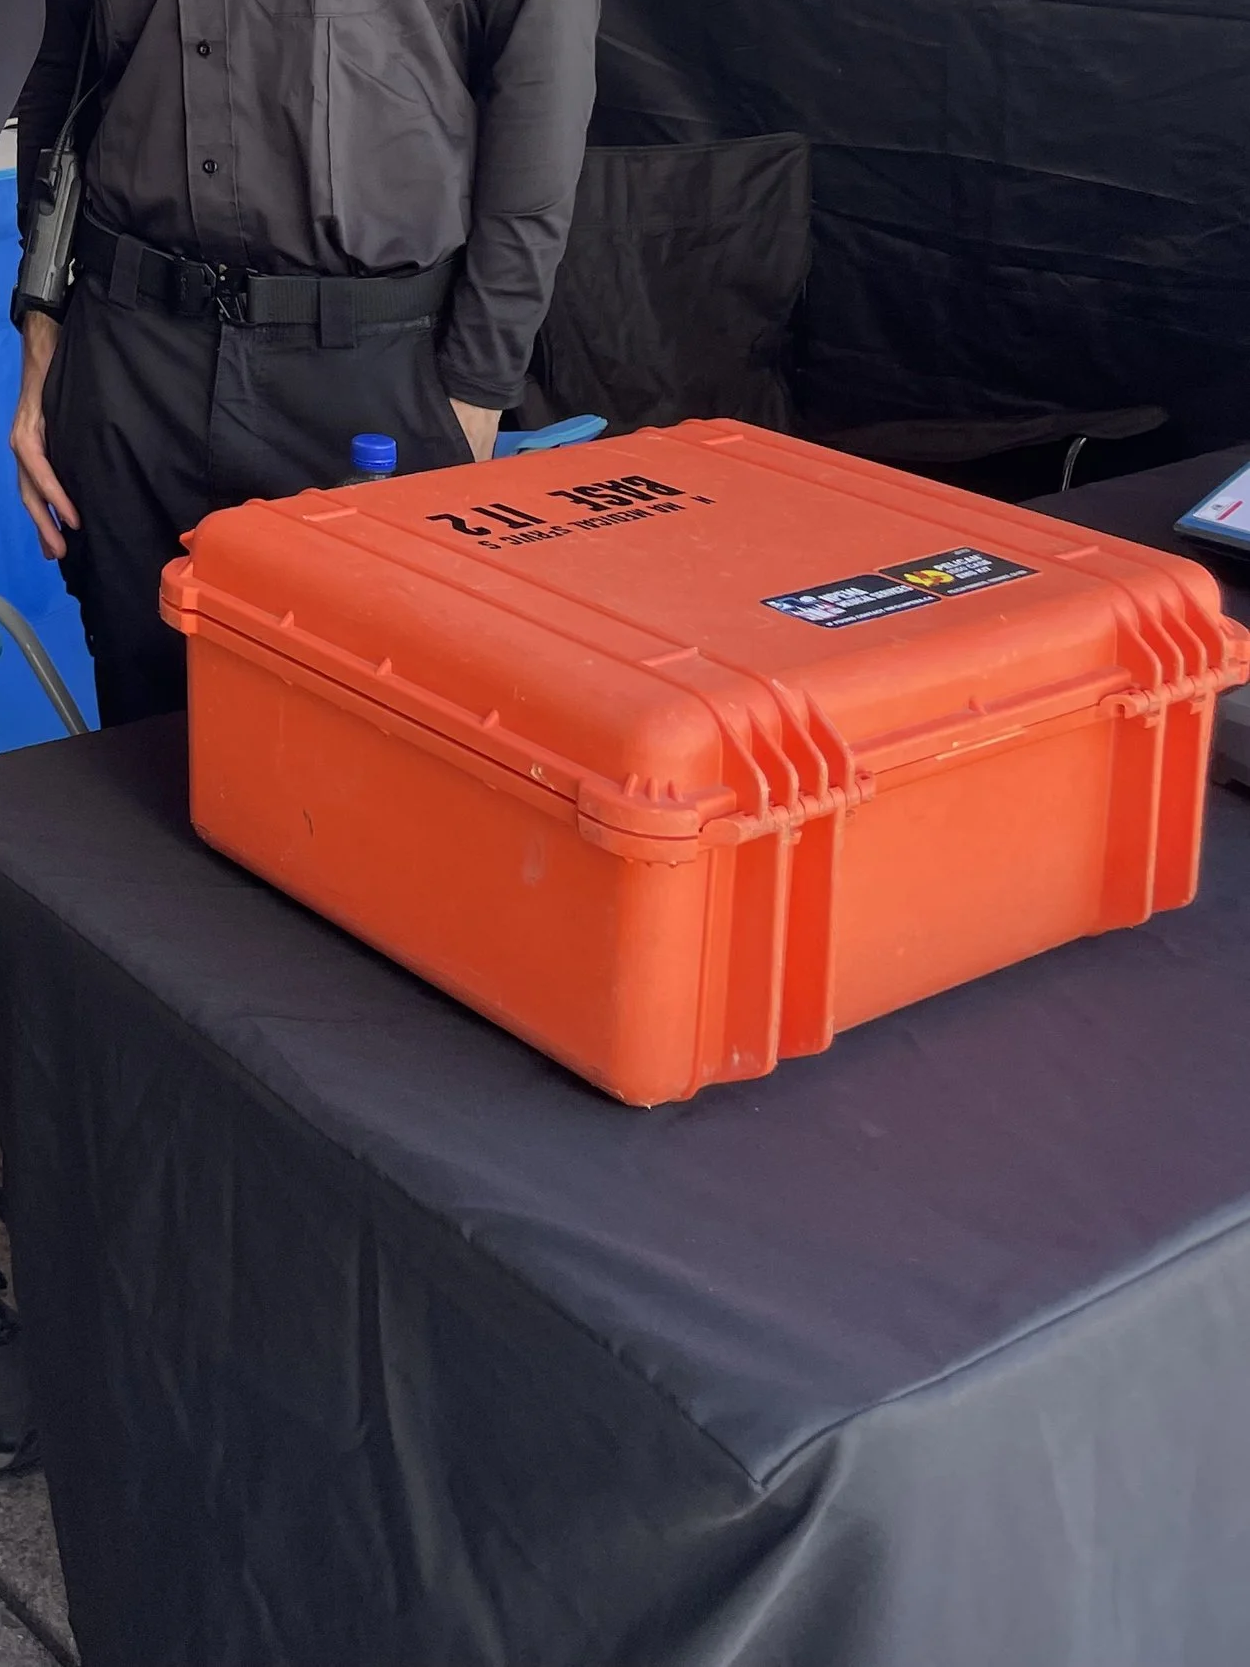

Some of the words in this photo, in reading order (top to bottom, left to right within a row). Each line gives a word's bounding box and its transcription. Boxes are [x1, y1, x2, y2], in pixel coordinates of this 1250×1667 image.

[546, 475, 687, 512] BASE
[425, 513, 491, 536] 2
[566, 506, 655, 531] MEDICAL
